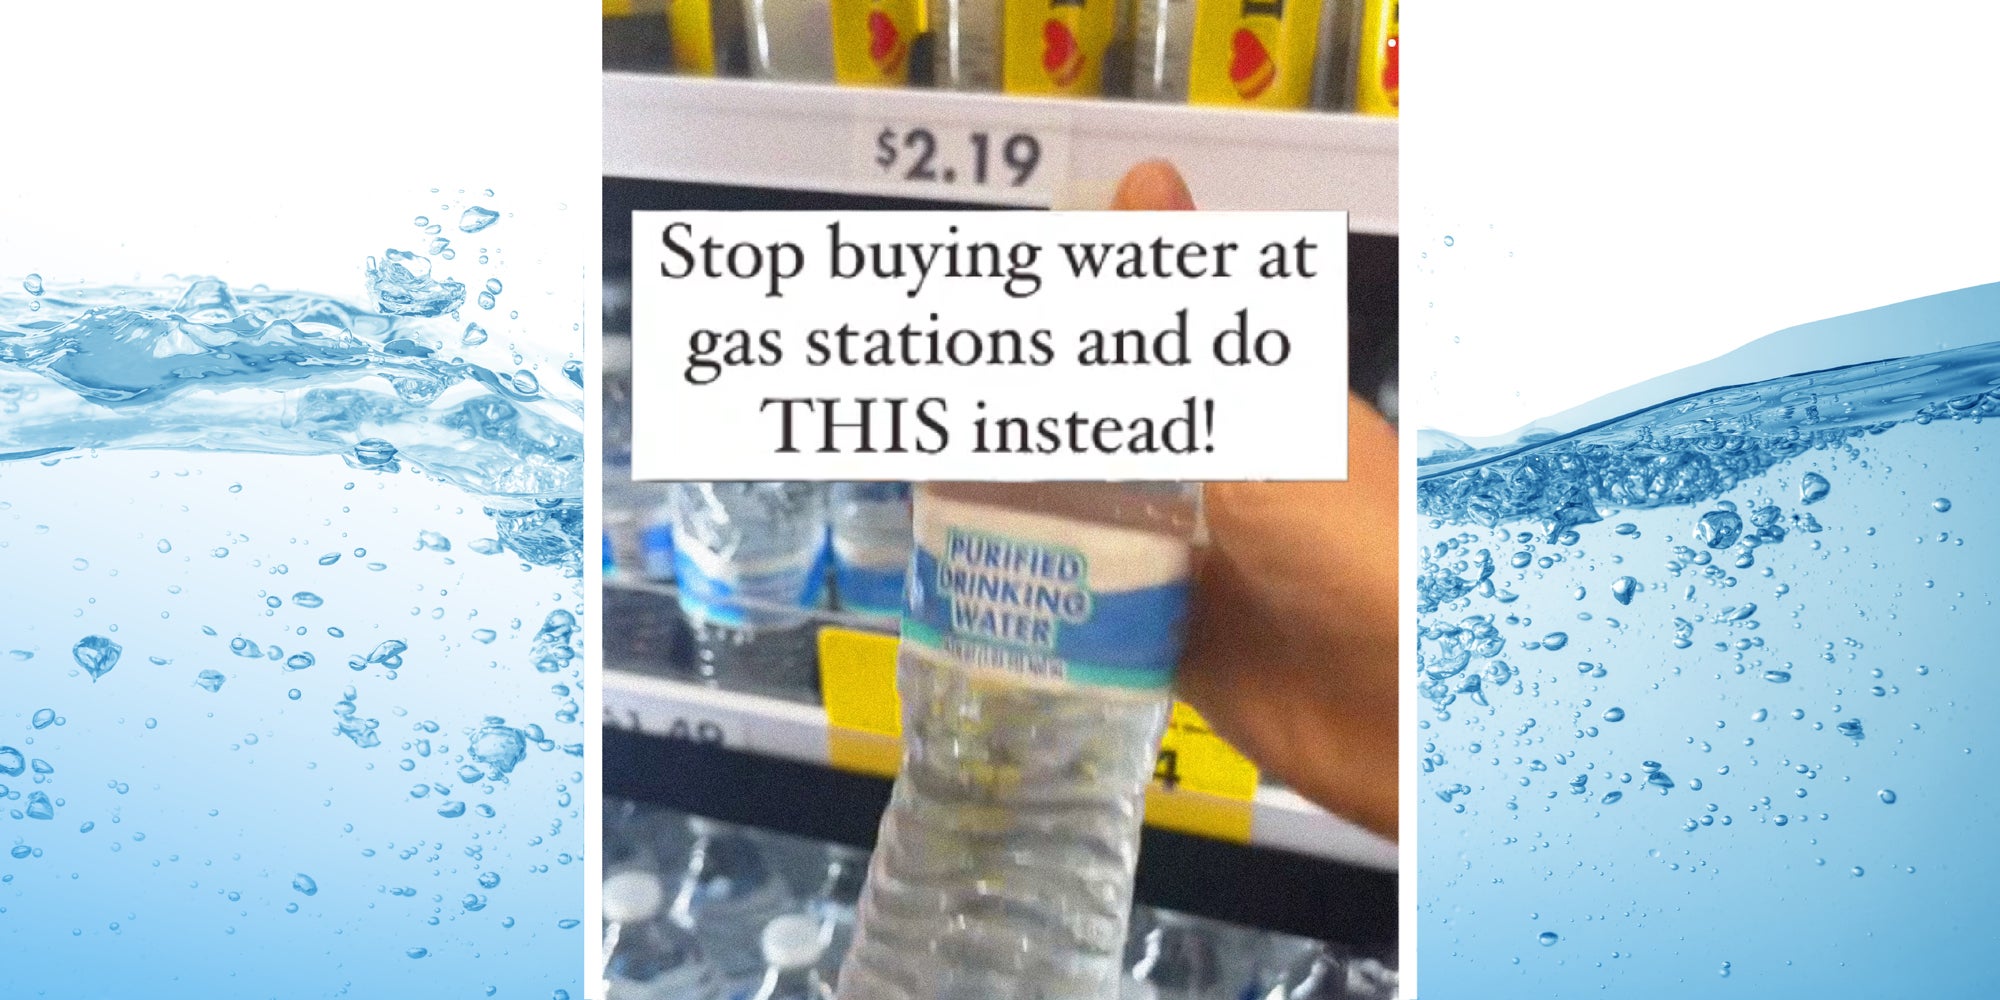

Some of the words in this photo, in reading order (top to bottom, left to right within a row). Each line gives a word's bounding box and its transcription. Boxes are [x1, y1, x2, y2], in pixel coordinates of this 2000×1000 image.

[877, 127, 1042, 188] $2.19
[951, 533, 1081, 582] PURIFIED
[940, 566, 1085, 619] DRINKING
[954, 600, 1051, 644] WATER
